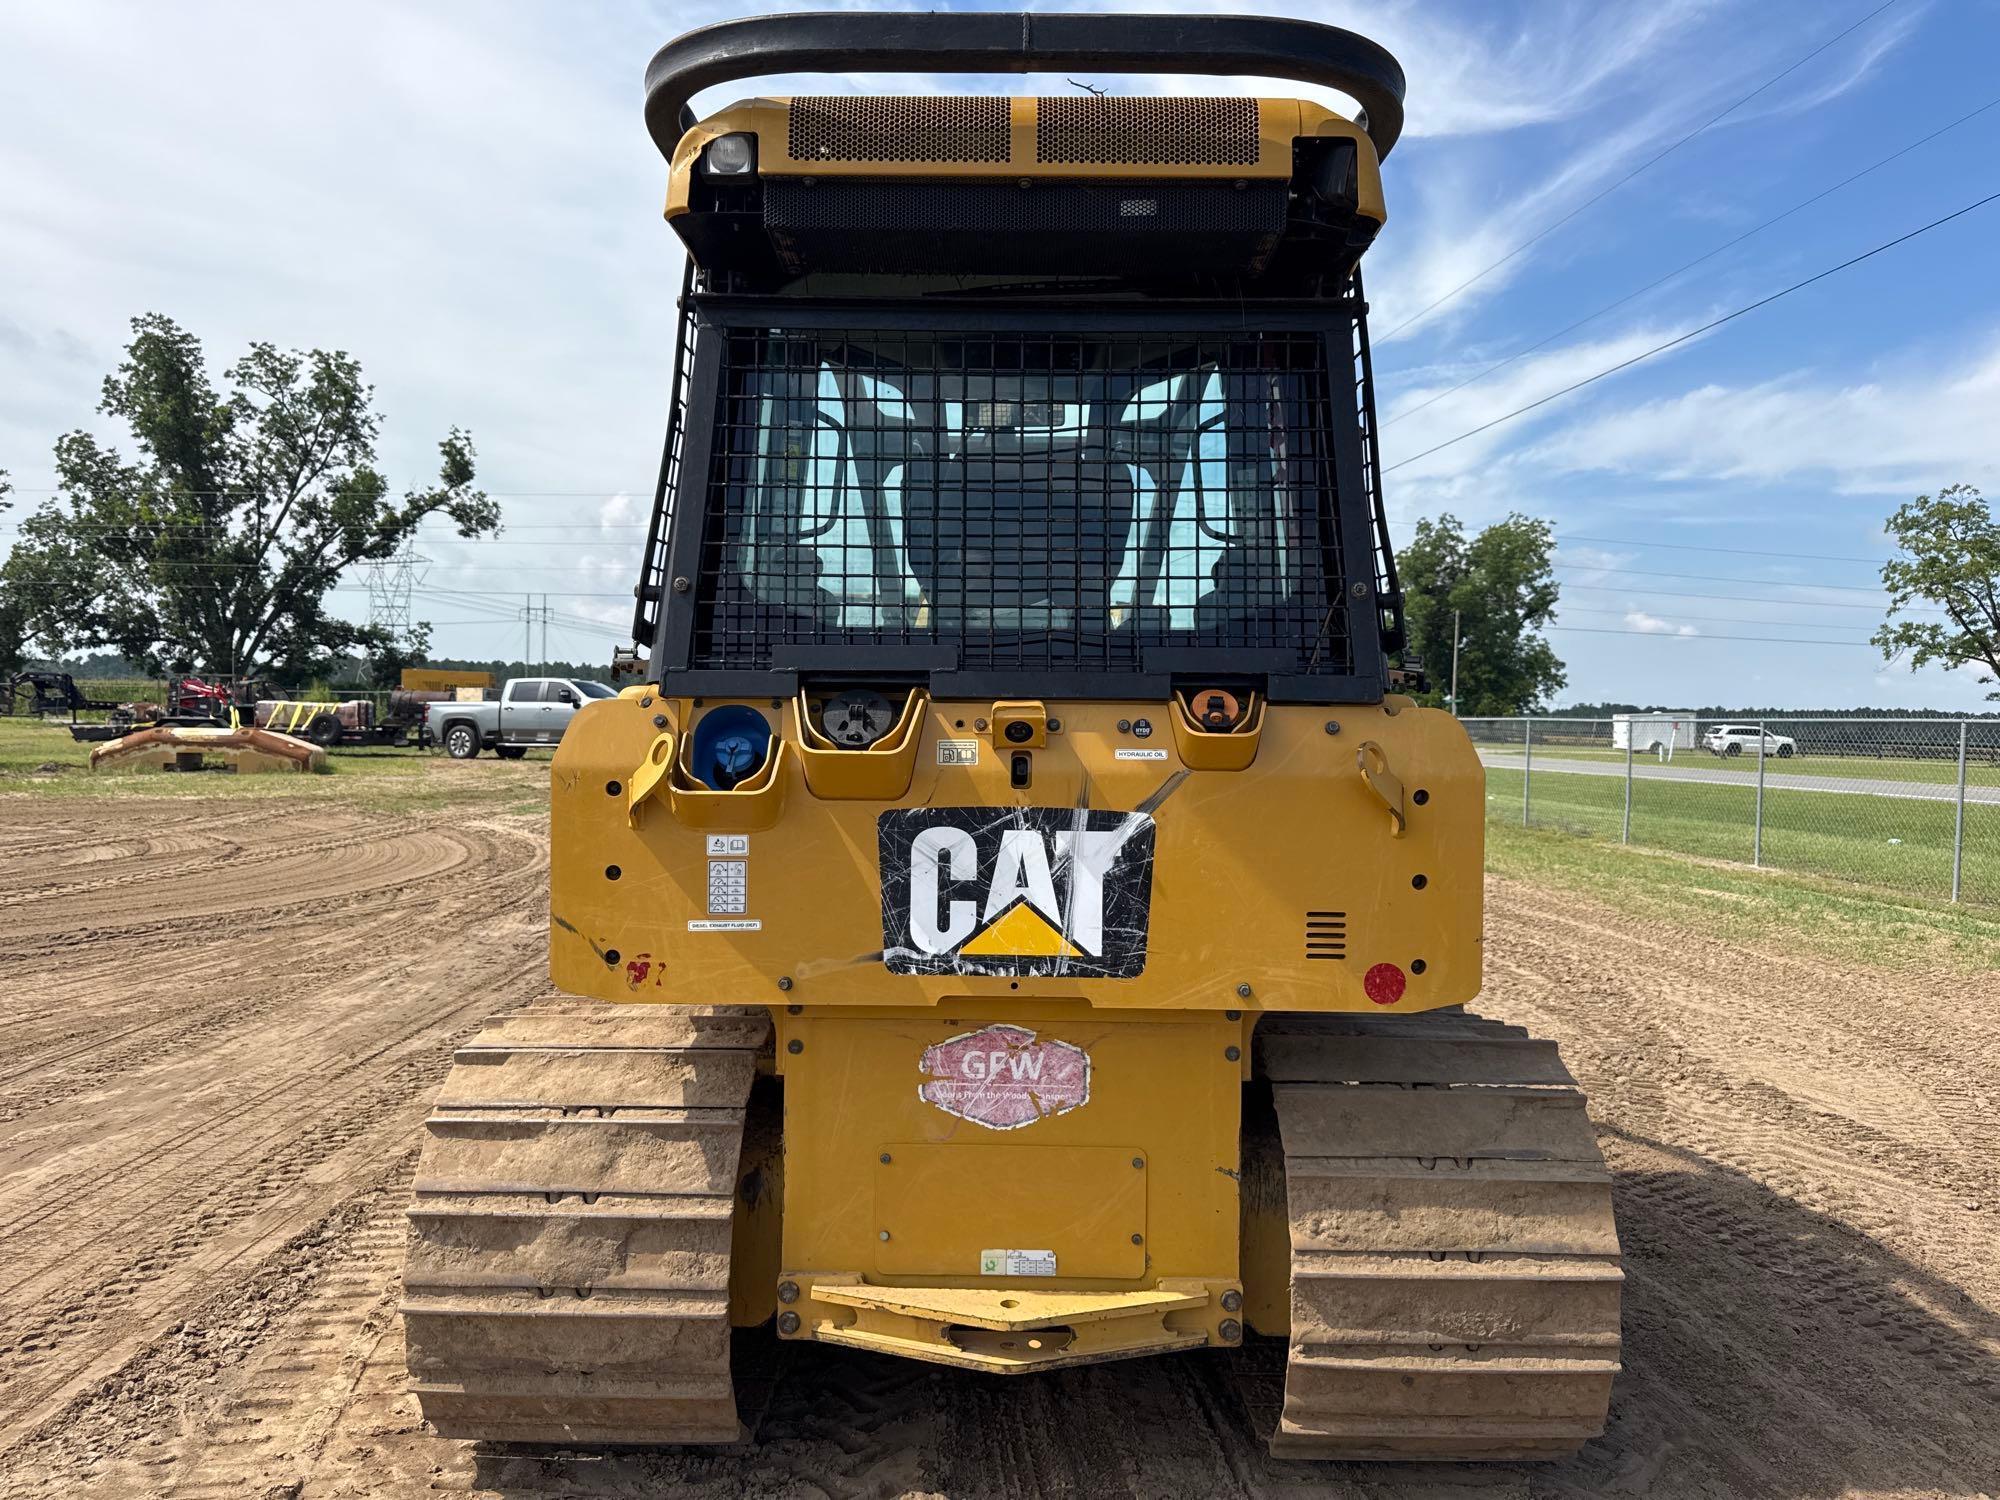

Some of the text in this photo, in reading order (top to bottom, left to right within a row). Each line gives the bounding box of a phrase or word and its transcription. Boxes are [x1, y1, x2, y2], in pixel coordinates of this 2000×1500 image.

[910, 826, 1122, 957] CAT
[961, 1051, 1045, 1080] GFW
[987, 1091, 1001, 1099] the
